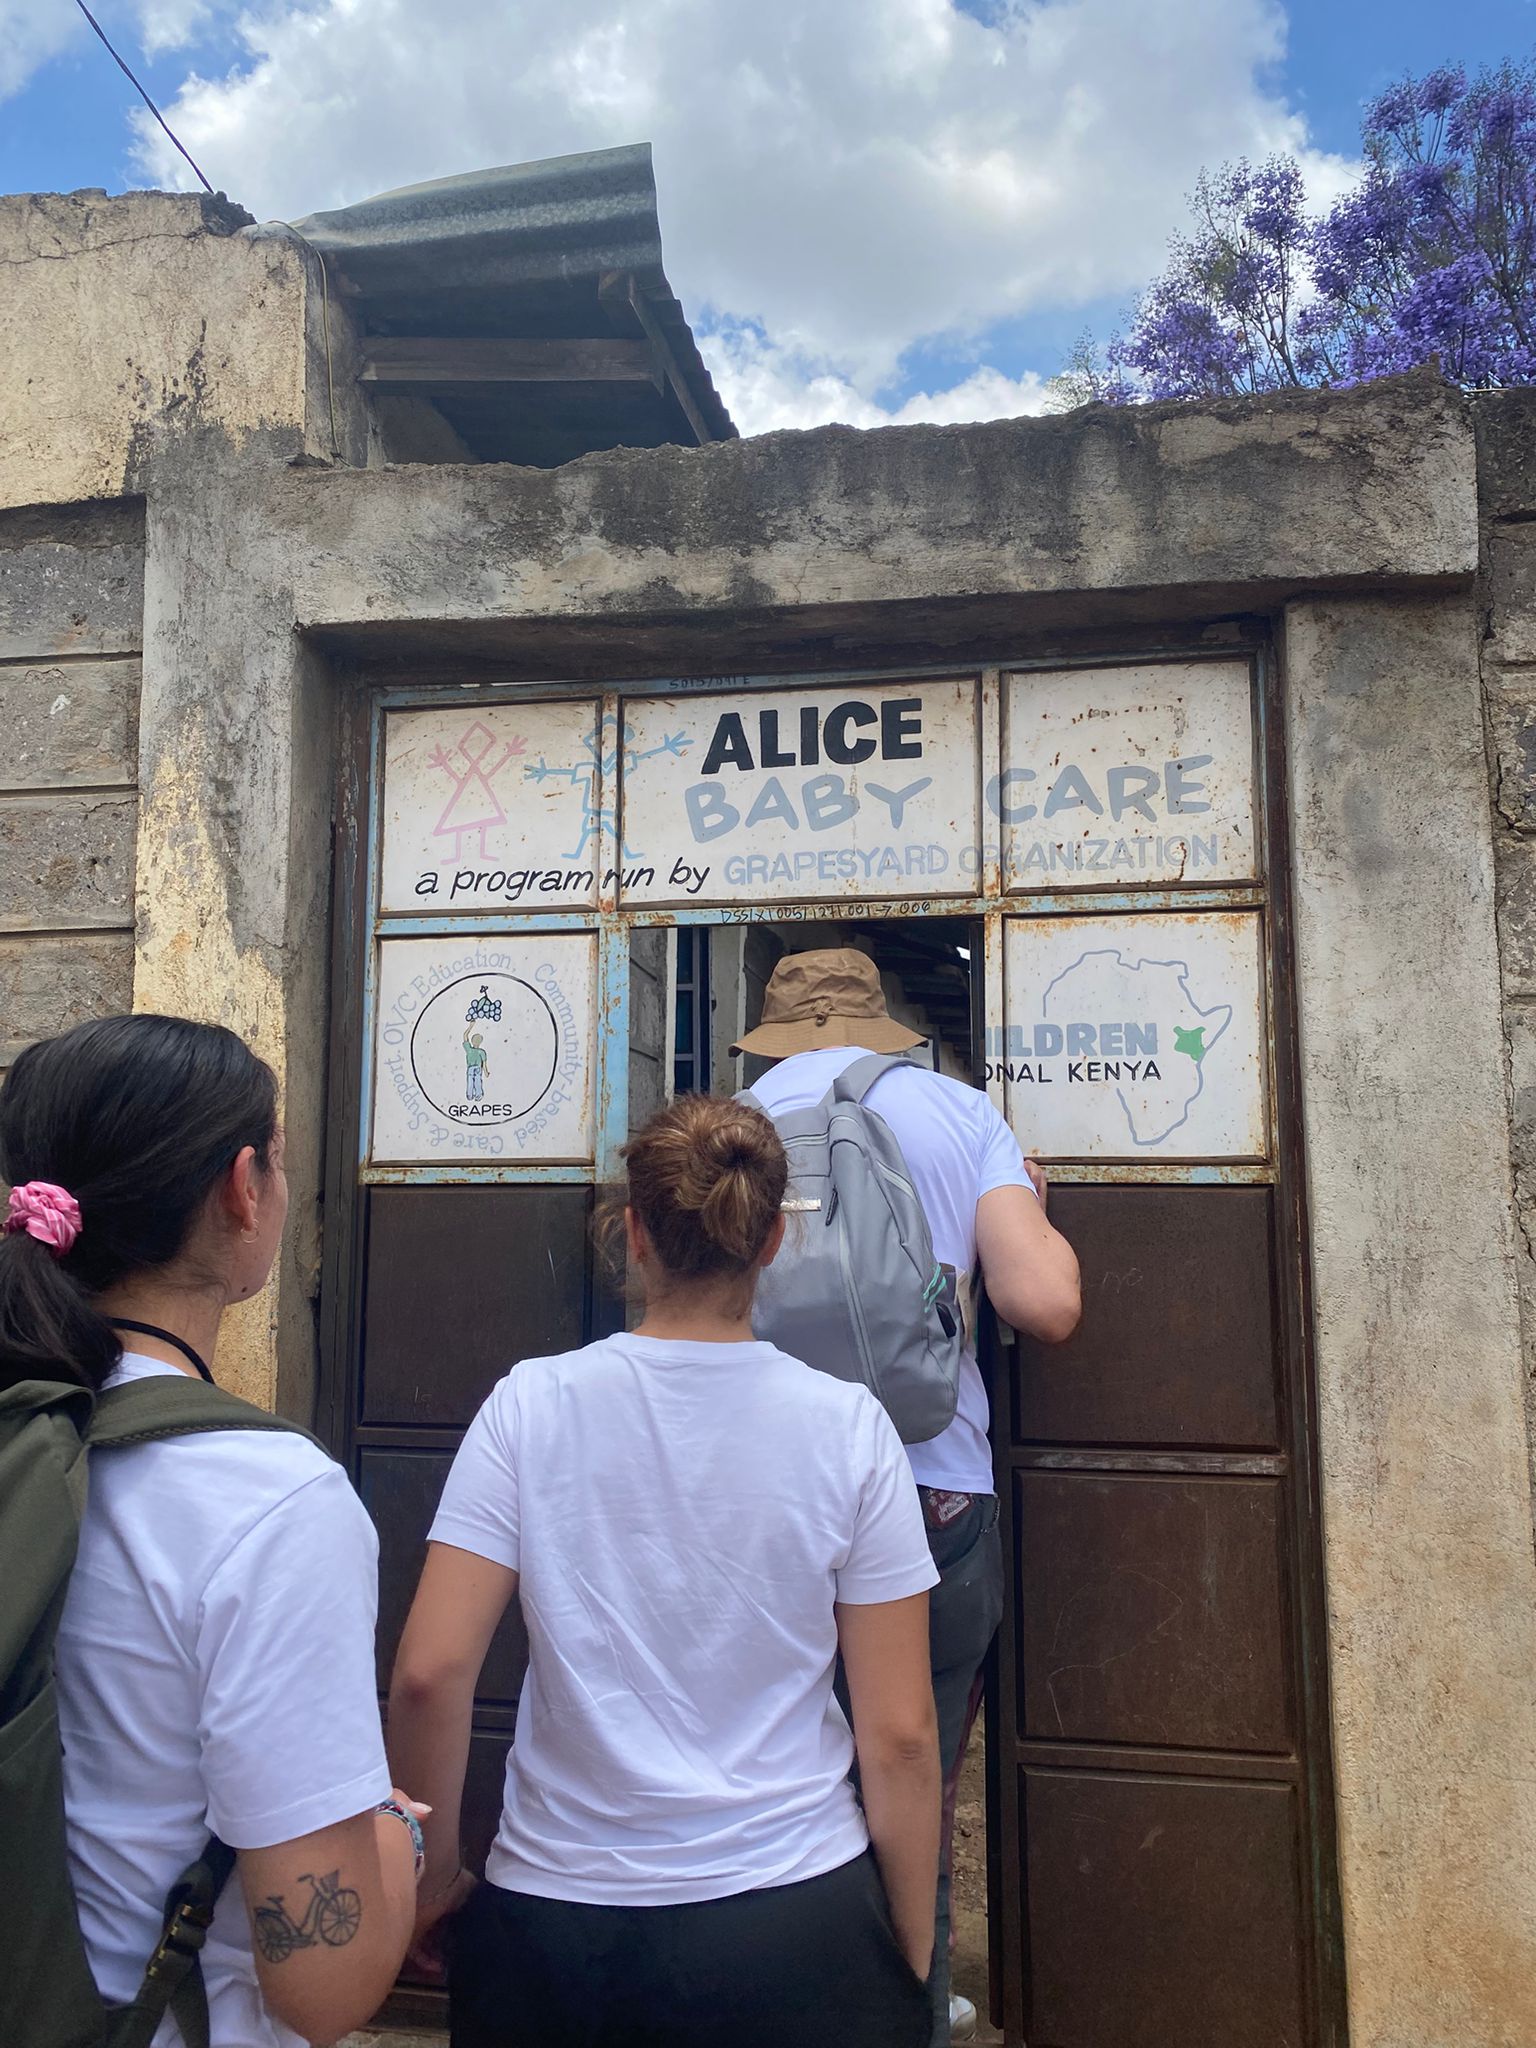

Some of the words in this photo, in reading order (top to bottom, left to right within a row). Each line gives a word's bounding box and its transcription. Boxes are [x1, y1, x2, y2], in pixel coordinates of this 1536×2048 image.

[700, 698, 923, 775] ALICE
[685, 774, 933, 843] BABY
[985, 754, 1216, 824] CARE
[414, 869, 439, 895] a
[449, 866, 594, 901] program
[601, 865, 653, 890] run
[669, 856, 711, 894] by
[723, 845, 949, 885] GRAPESYARD
[958, 833, 1219, 874] ORGANIZATION
[410, 949, 517, 998] Education,
[383, 993, 418, 1046] OVC
[1067, 1060, 1163, 1083] KENYA
[448, 1103, 513, 1118] GRAPES
[428, 1124, 450, 1148] &
[453, 1134, 505, 1154] Care
